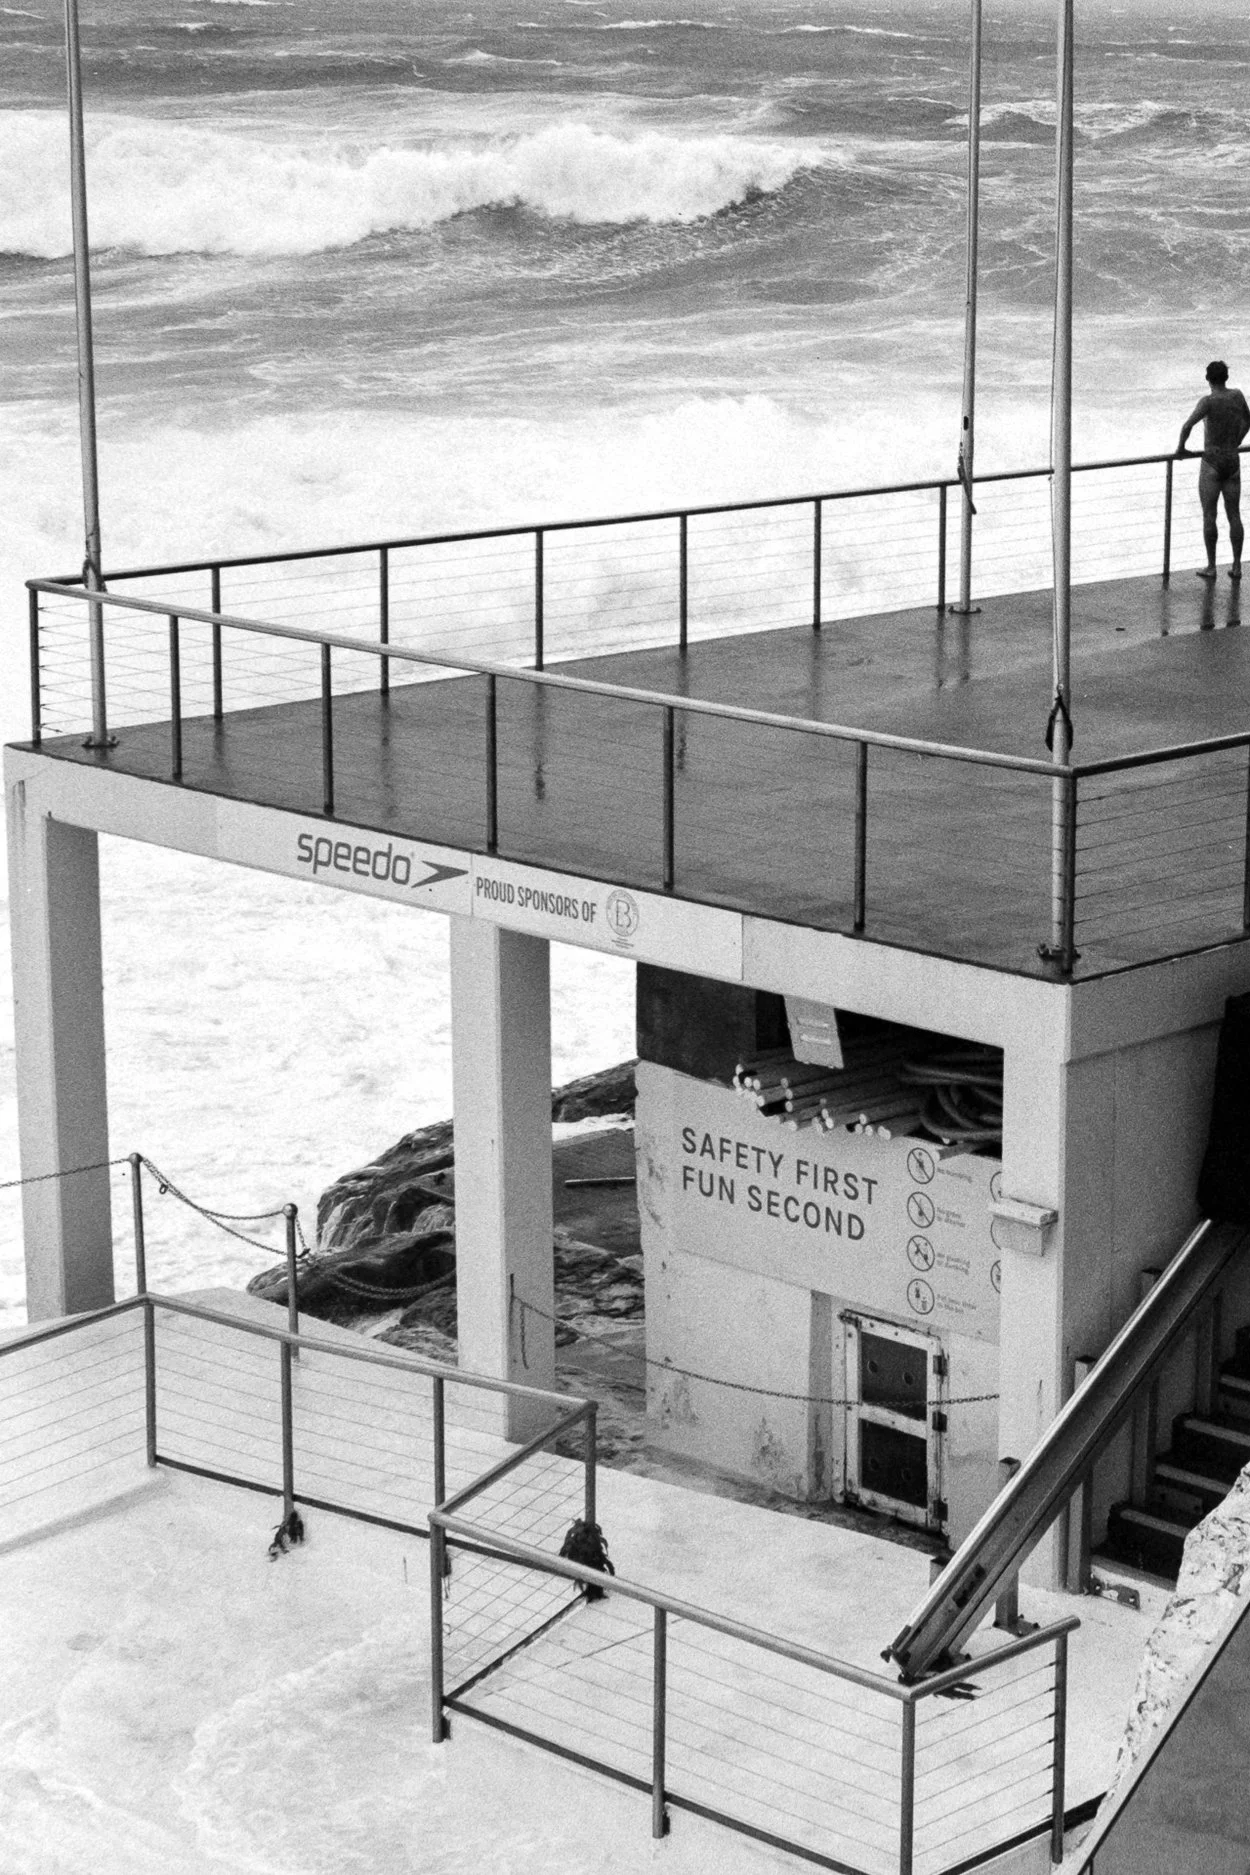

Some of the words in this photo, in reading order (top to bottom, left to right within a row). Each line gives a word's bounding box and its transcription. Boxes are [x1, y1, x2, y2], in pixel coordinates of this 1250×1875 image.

[298, 833, 411, 886] speedo
[475, 876, 515, 905] PROUD
[517, 885, 580, 921] SPONSORS
[582, 900, 598, 924] OF
[681, 1125, 785, 1180] SAFETY
[796, 1158, 879, 1206] FIRST
[681, 1163, 736, 1206] FUN
[747, 1184, 867, 1242] SECOND
